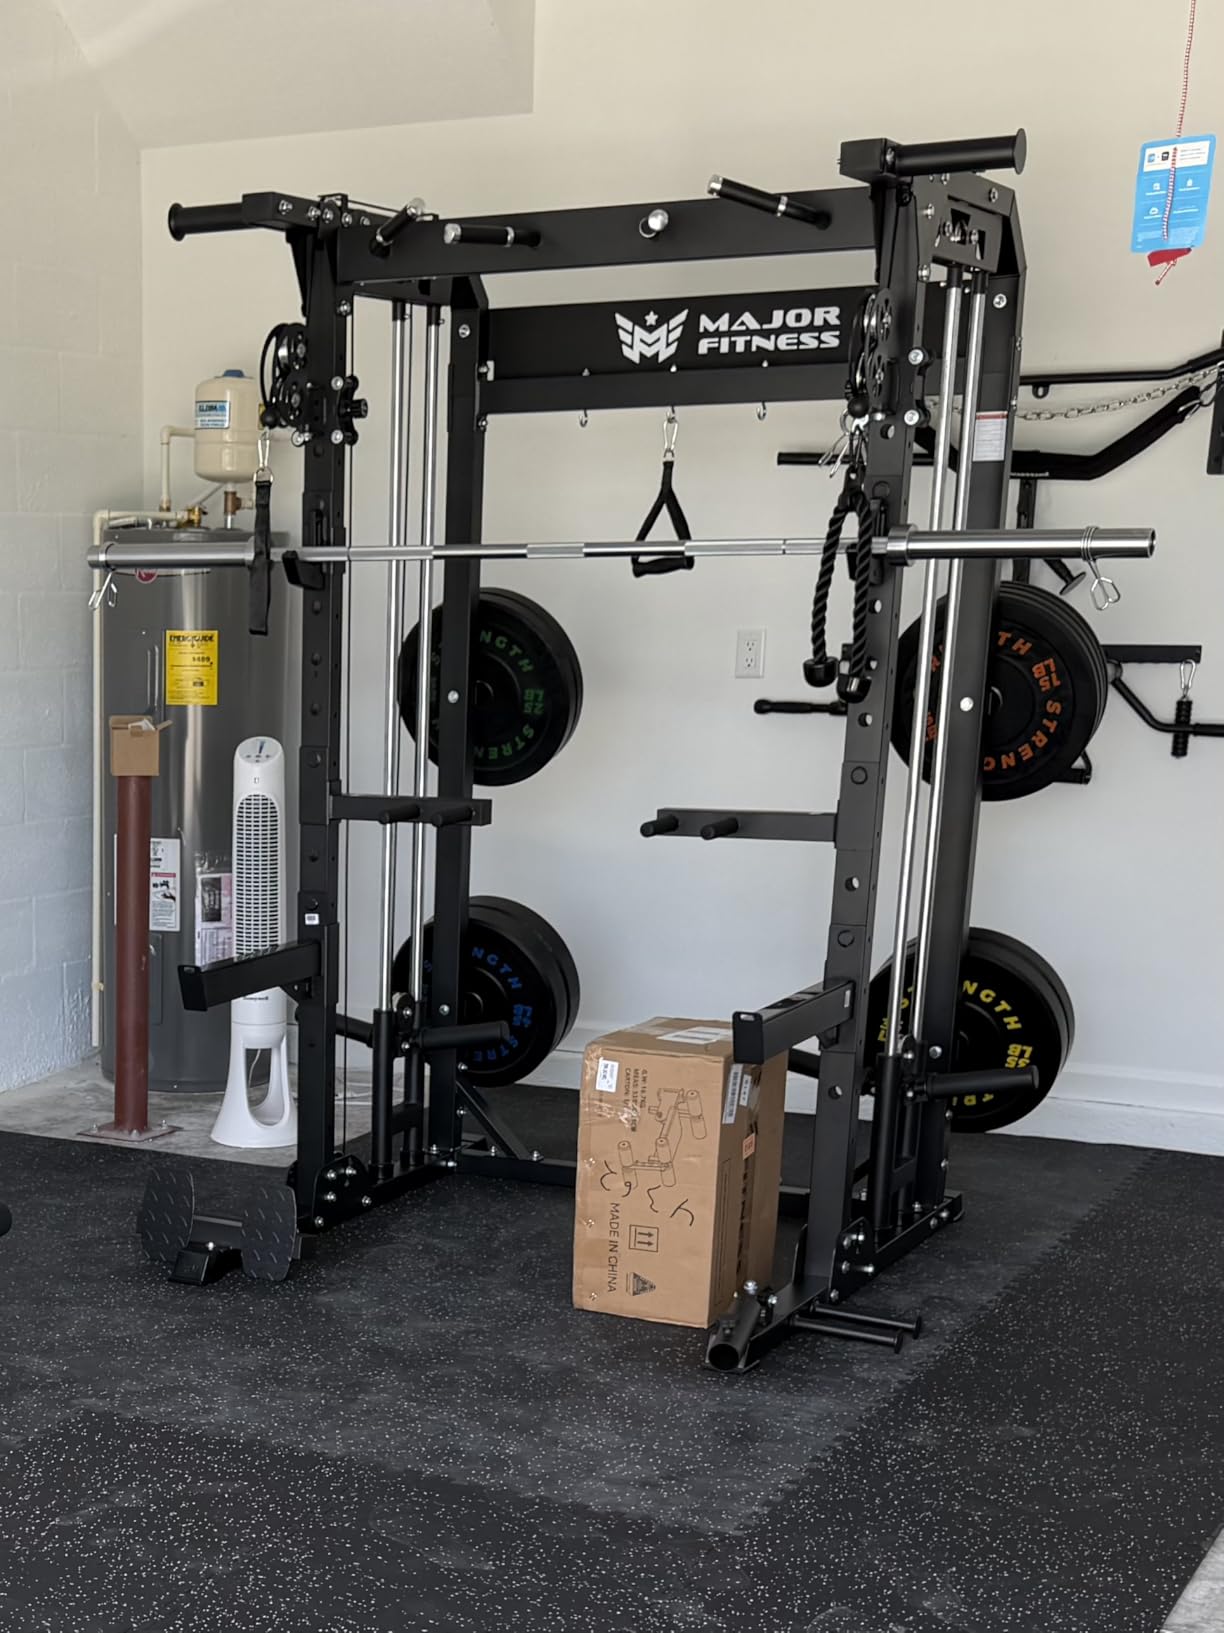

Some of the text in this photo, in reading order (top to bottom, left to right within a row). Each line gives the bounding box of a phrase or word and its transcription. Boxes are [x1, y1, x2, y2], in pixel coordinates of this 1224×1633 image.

[699, 306, 841, 333] MAJOR
[698, 331, 840, 355] FITNESS
[607, 1202, 620, 1293] MADE IN CHINA
